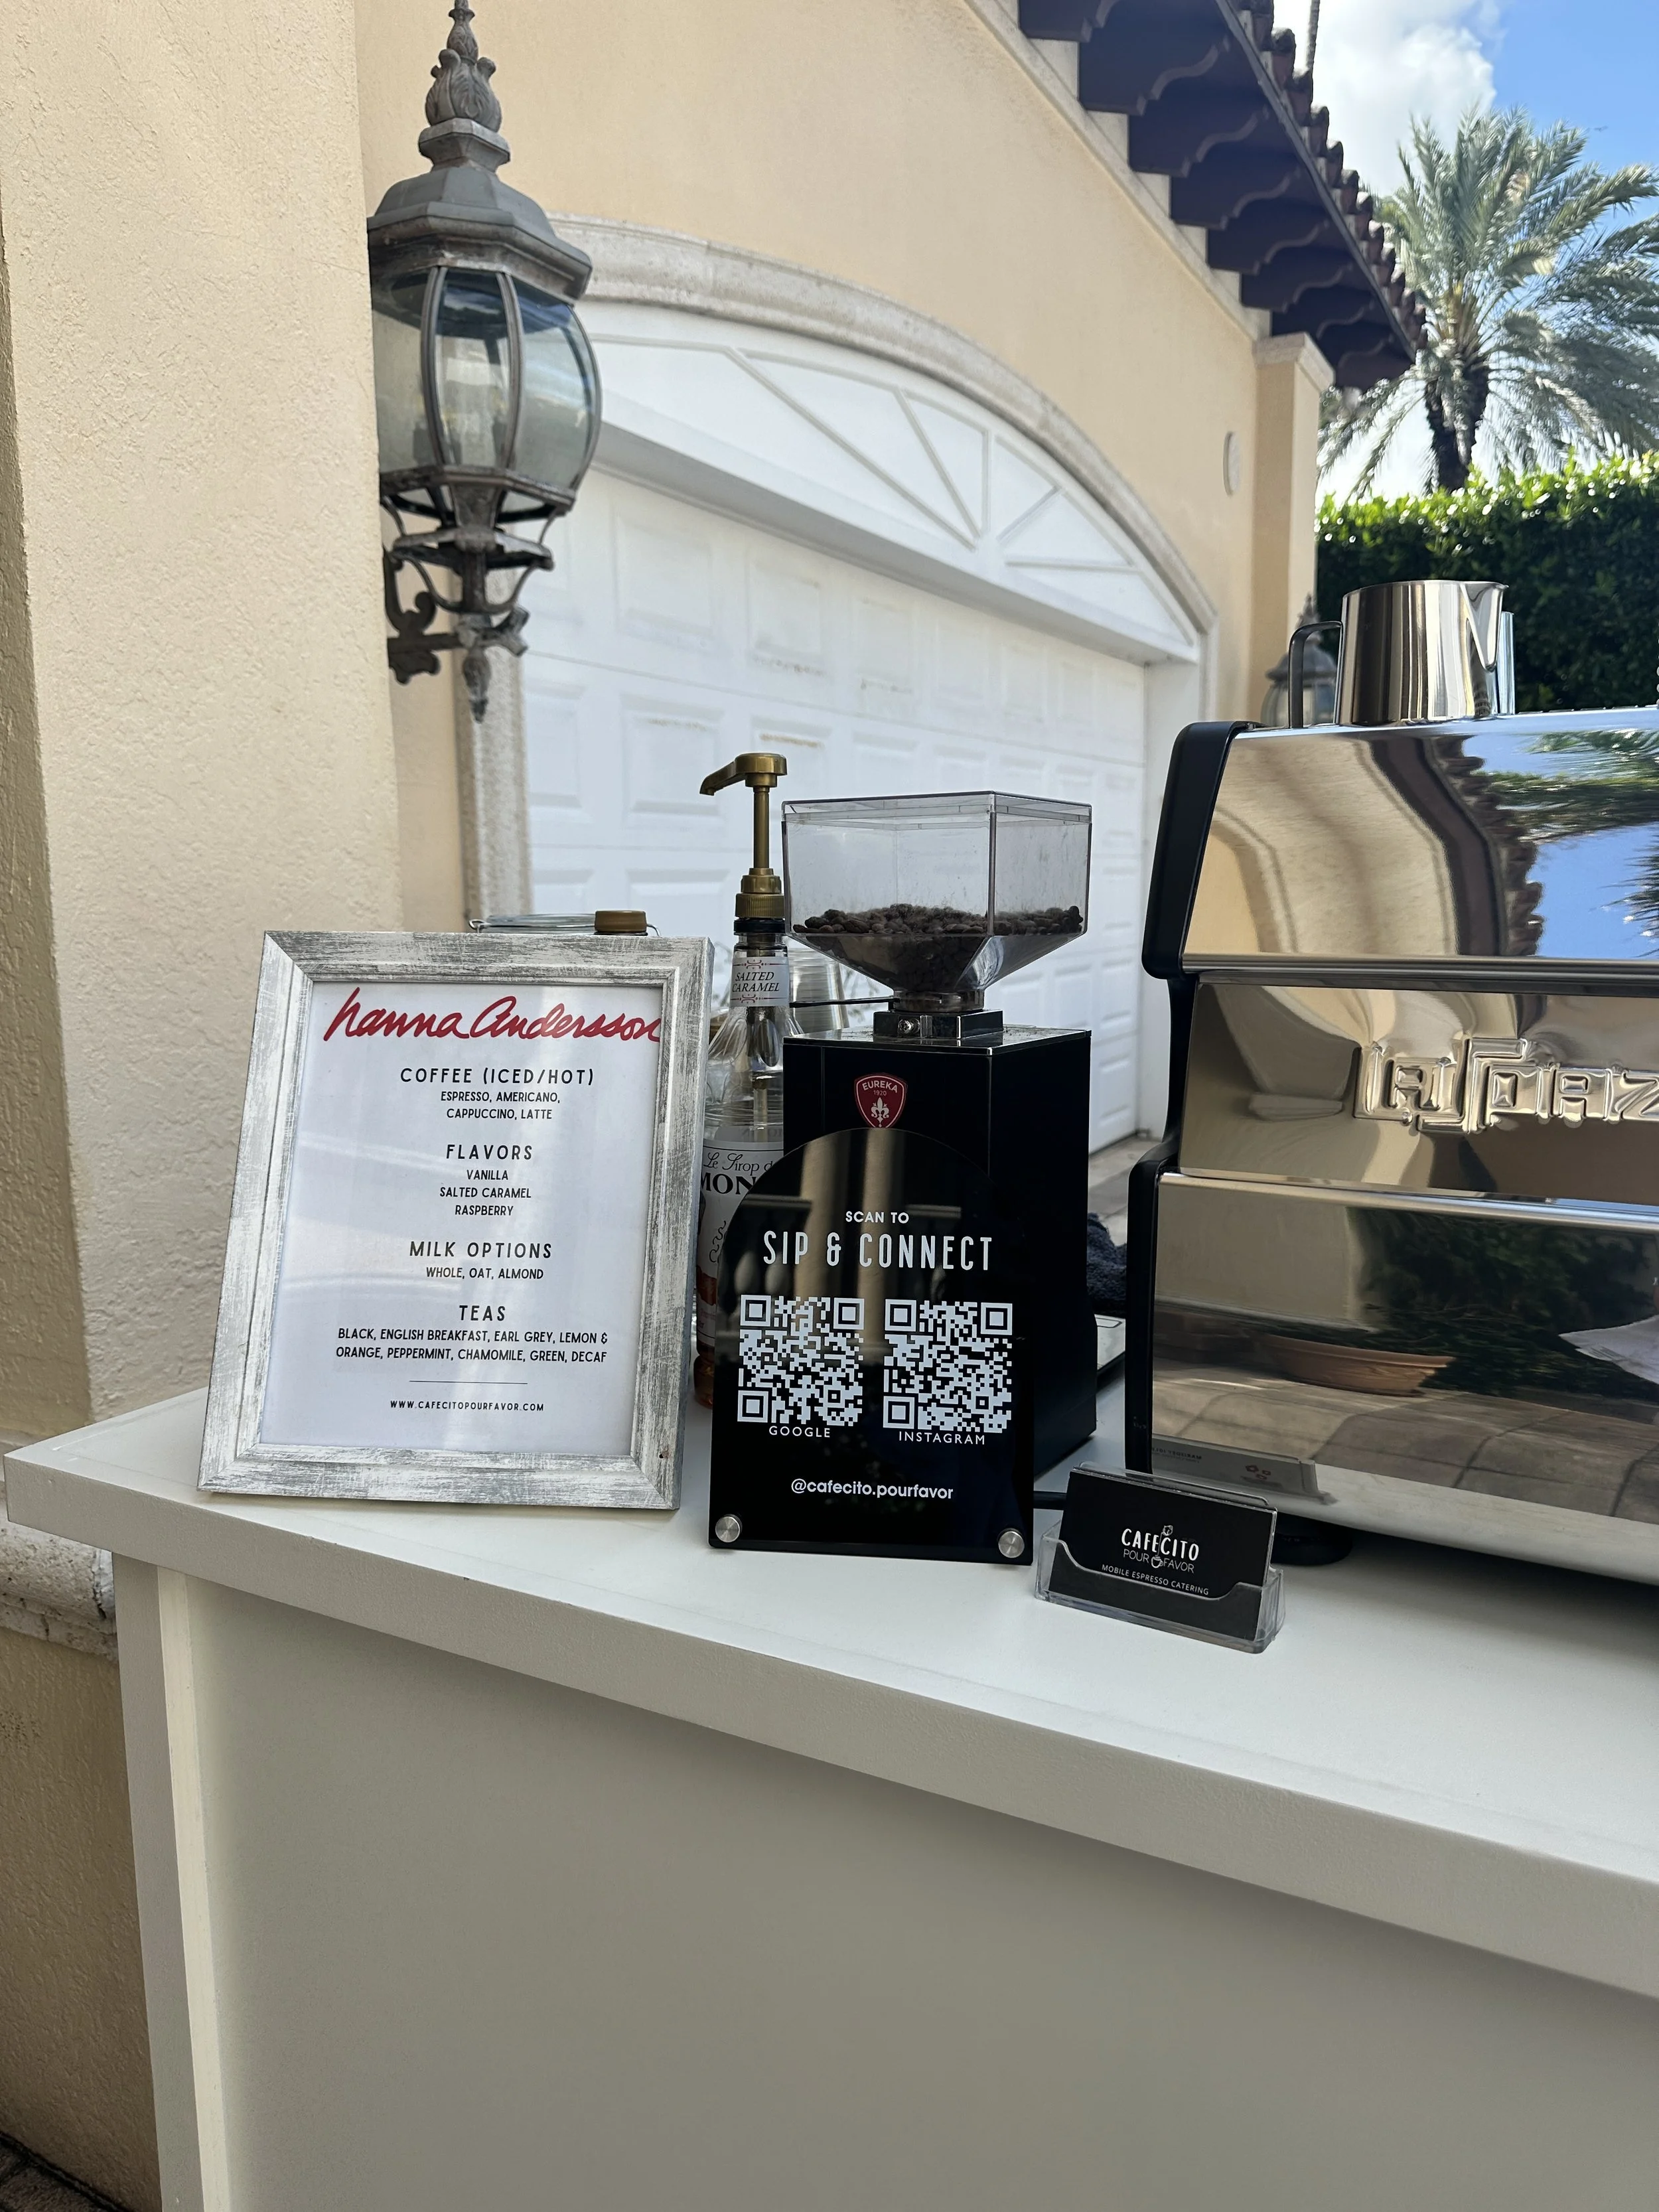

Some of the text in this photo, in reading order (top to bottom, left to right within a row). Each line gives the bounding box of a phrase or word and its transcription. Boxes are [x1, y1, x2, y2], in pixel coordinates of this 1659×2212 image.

[735, 972, 774, 982] SALTED
[732, 982, 780, 992] CARAMEL
[324, 986, 661, 1043] hanna Andersson
[400, 1067, 594, 1086] COFFEE (ICED/HOT)
[863, 1080, 898, 1093] EUREKA
[441, 1091, 560, 1104] ESPRESSO, AMERICANO,
[447, 1108, 553, 1121] CAPPUCCINO, LATTE
[446, 1143, 532, 1160] FLAVORS
[703, 1152, 720, 1169] Le
[722, 1153, 760, 1176] Sirop
[466, 1169, 509, 1181] VANILLA
[701, 1172, 757, 1195] MON
[440, 1187, 532, 1199] SALTED CARAMEL
[455, 1205, 514, 1217] RASPBERRY
[845, 1211, 909, 1224] SCAN TO
[409, 1240, 552, 1259] MILK OPTIONS
[763, 1230, 809, 1264] SIP
[826, 1232, 842, 1267] &
[859, 1233, 993, 1271] CONNECT
[426, 1266, 544, 1280] WHOLE, OAT, ALMOND
[459, 1305, 506, 1322] TEAS
[338, 1328, 608, 1345] BLACK, ENGLISH BREAKFAST, EARL GREY, LEMON &
[336, 1347, 607, 1364] ORANGE, PEPPERMINT, CHAMOMILE, GREEN, DECAF
[390, 1400, 545, 1412] WWW.CAFECITOPOURFAVOR.COM
[768, 1426, 831, 1439] GOOGLE
[899, 1431, 985, 1445] INSTAGRAM
[790, 1479, 954, 1499] @cafecito.pourfavor
[1121, 1528, 1199, 1561] CAFECITO
[1123, 1548, 1194, 1574] POUR FAVOR
[1102, 1564, 1209, 1595] MOBILE ESPRESSO CATERING
